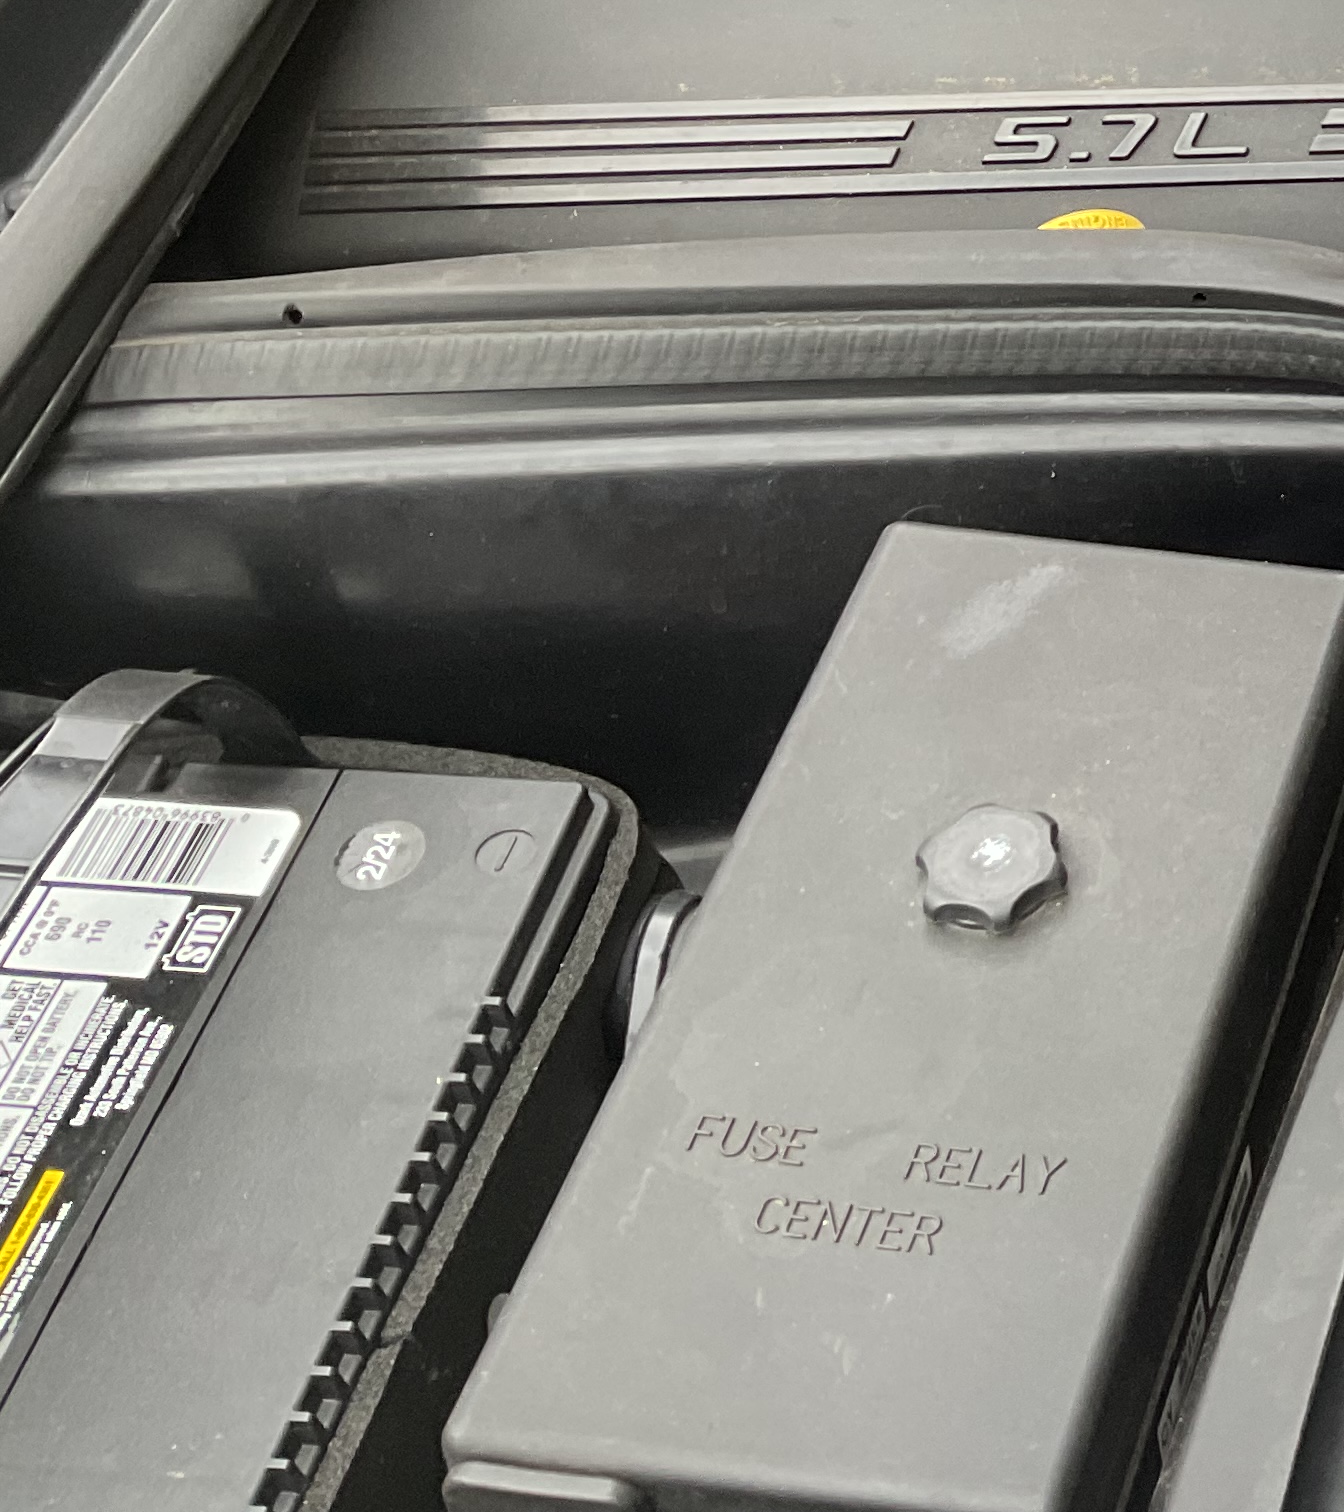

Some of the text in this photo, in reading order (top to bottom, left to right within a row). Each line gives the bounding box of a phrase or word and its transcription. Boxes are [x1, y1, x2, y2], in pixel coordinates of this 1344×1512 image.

[981, 112, 1251, 167] 5.7L
[112, 803, 163, 819] 04873
[171, 808, 222, 824] 83996
[355, 829, 402, 882] 2/24
[19, 931, 37, 957] CCA
[45, 916, 72, 942] 690
[71, 922, 89, 939] RC
[86, 919, 112, 944] 110
[144, 919, 170, 950] 12V
[175, 913, 230, 965] STD
[2, 979, 24, 999] GET
[3, 981, 41, 1028] MEDICAL
[9, 982, 57, 1043] HELP FAST.
[2, 1087, 21, 1101] DO
[12, 1064, 33, 1085] NOT
[25, 1035, 47, 1062] OPEN
[17, 1088, 35, 1101] DO
[27, 1064, 45, 1085] NOT
[686, 1114, 1068, 1196] FUSE RELAY
[754, 1196, 944, 1256] CENTER
